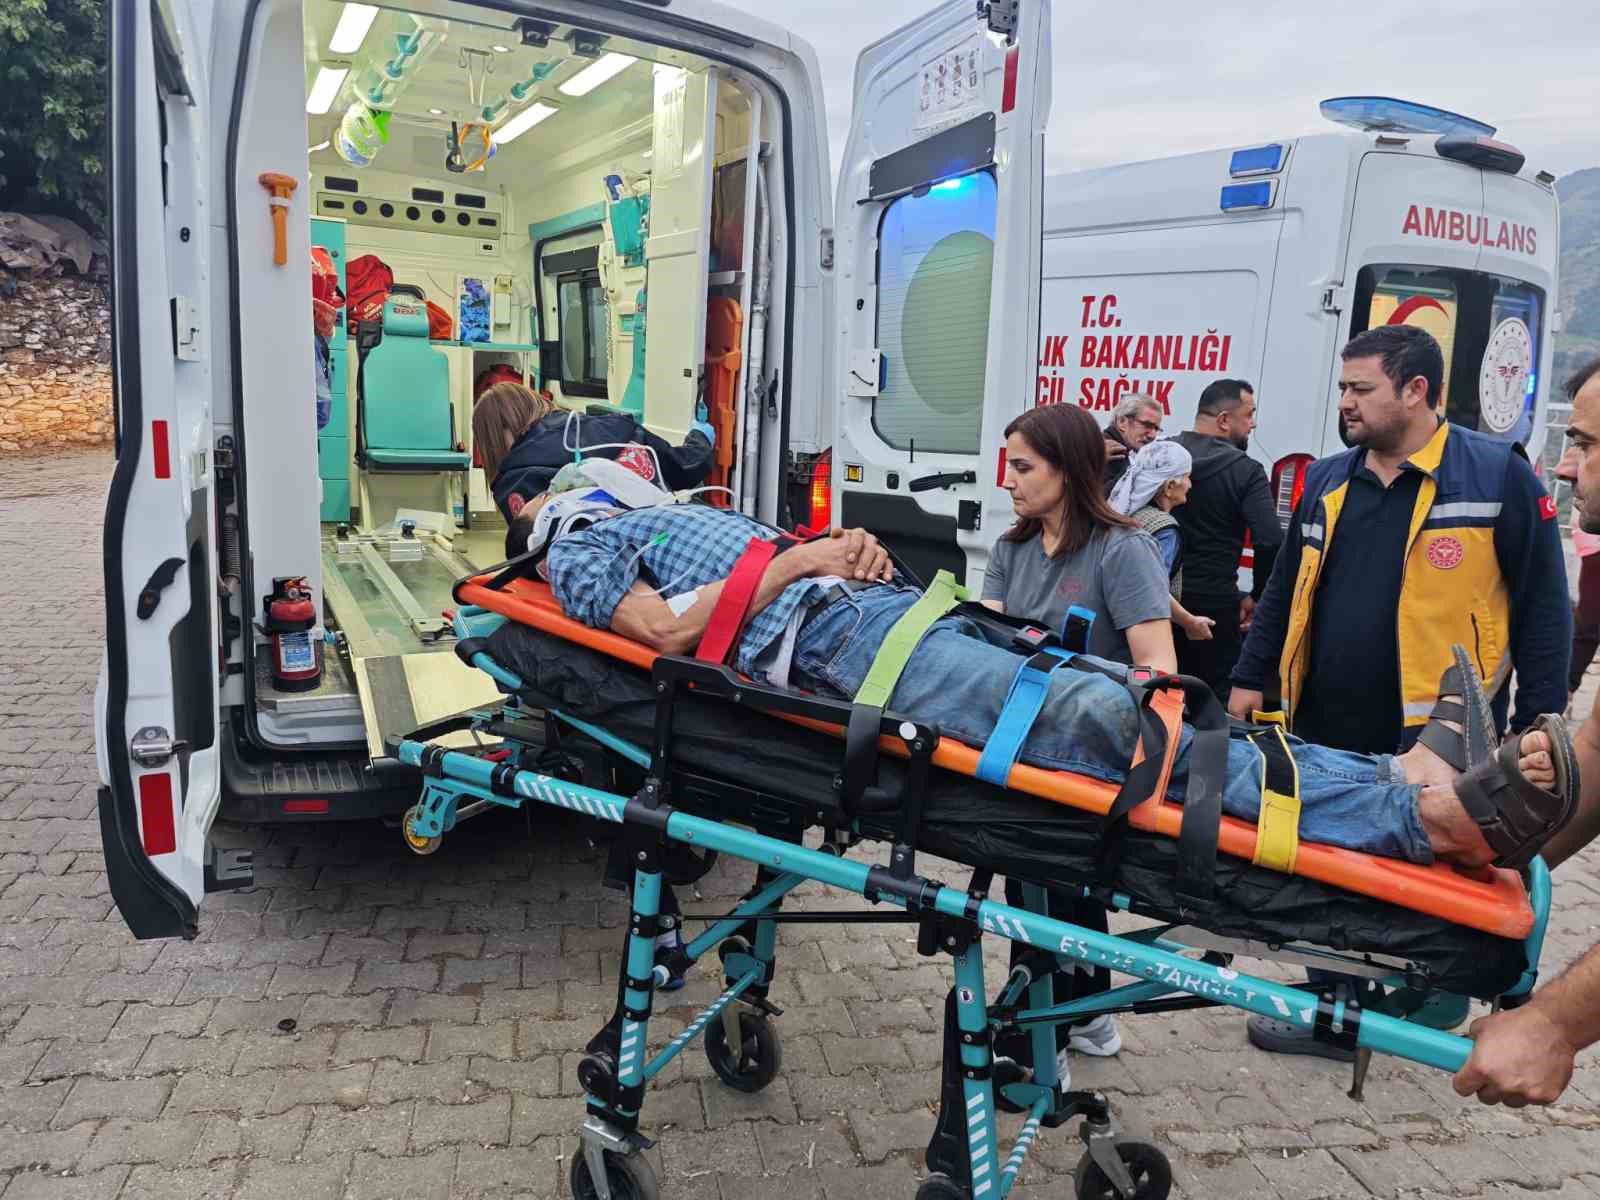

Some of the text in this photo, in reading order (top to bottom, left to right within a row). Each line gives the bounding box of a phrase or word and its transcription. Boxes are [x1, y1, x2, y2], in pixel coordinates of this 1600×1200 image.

[1401, 204, 1537, 255] AMBULANS
[1081, 294, 1122, 328] T.C.
[1039, 328, 1232, 371] IK BAKANLIĞI
